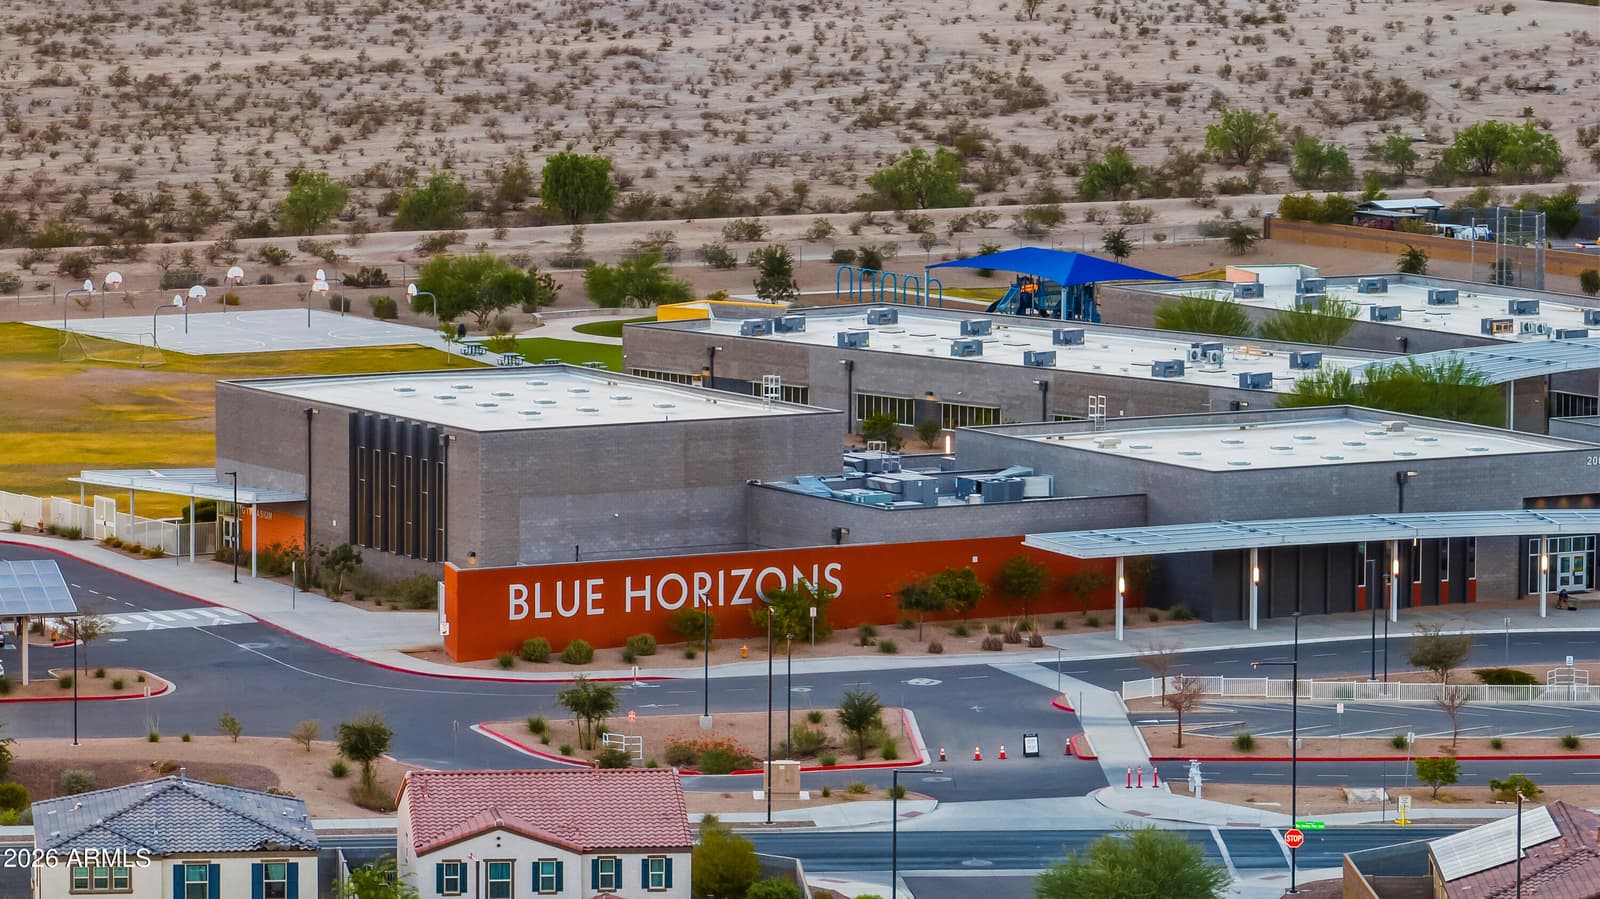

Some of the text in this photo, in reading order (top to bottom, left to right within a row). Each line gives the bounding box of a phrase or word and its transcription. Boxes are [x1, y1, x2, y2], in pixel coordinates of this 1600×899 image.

[1587, 456, 1600, 465] 20
[508, 563, 843, 621] BLUE HORIZONS
